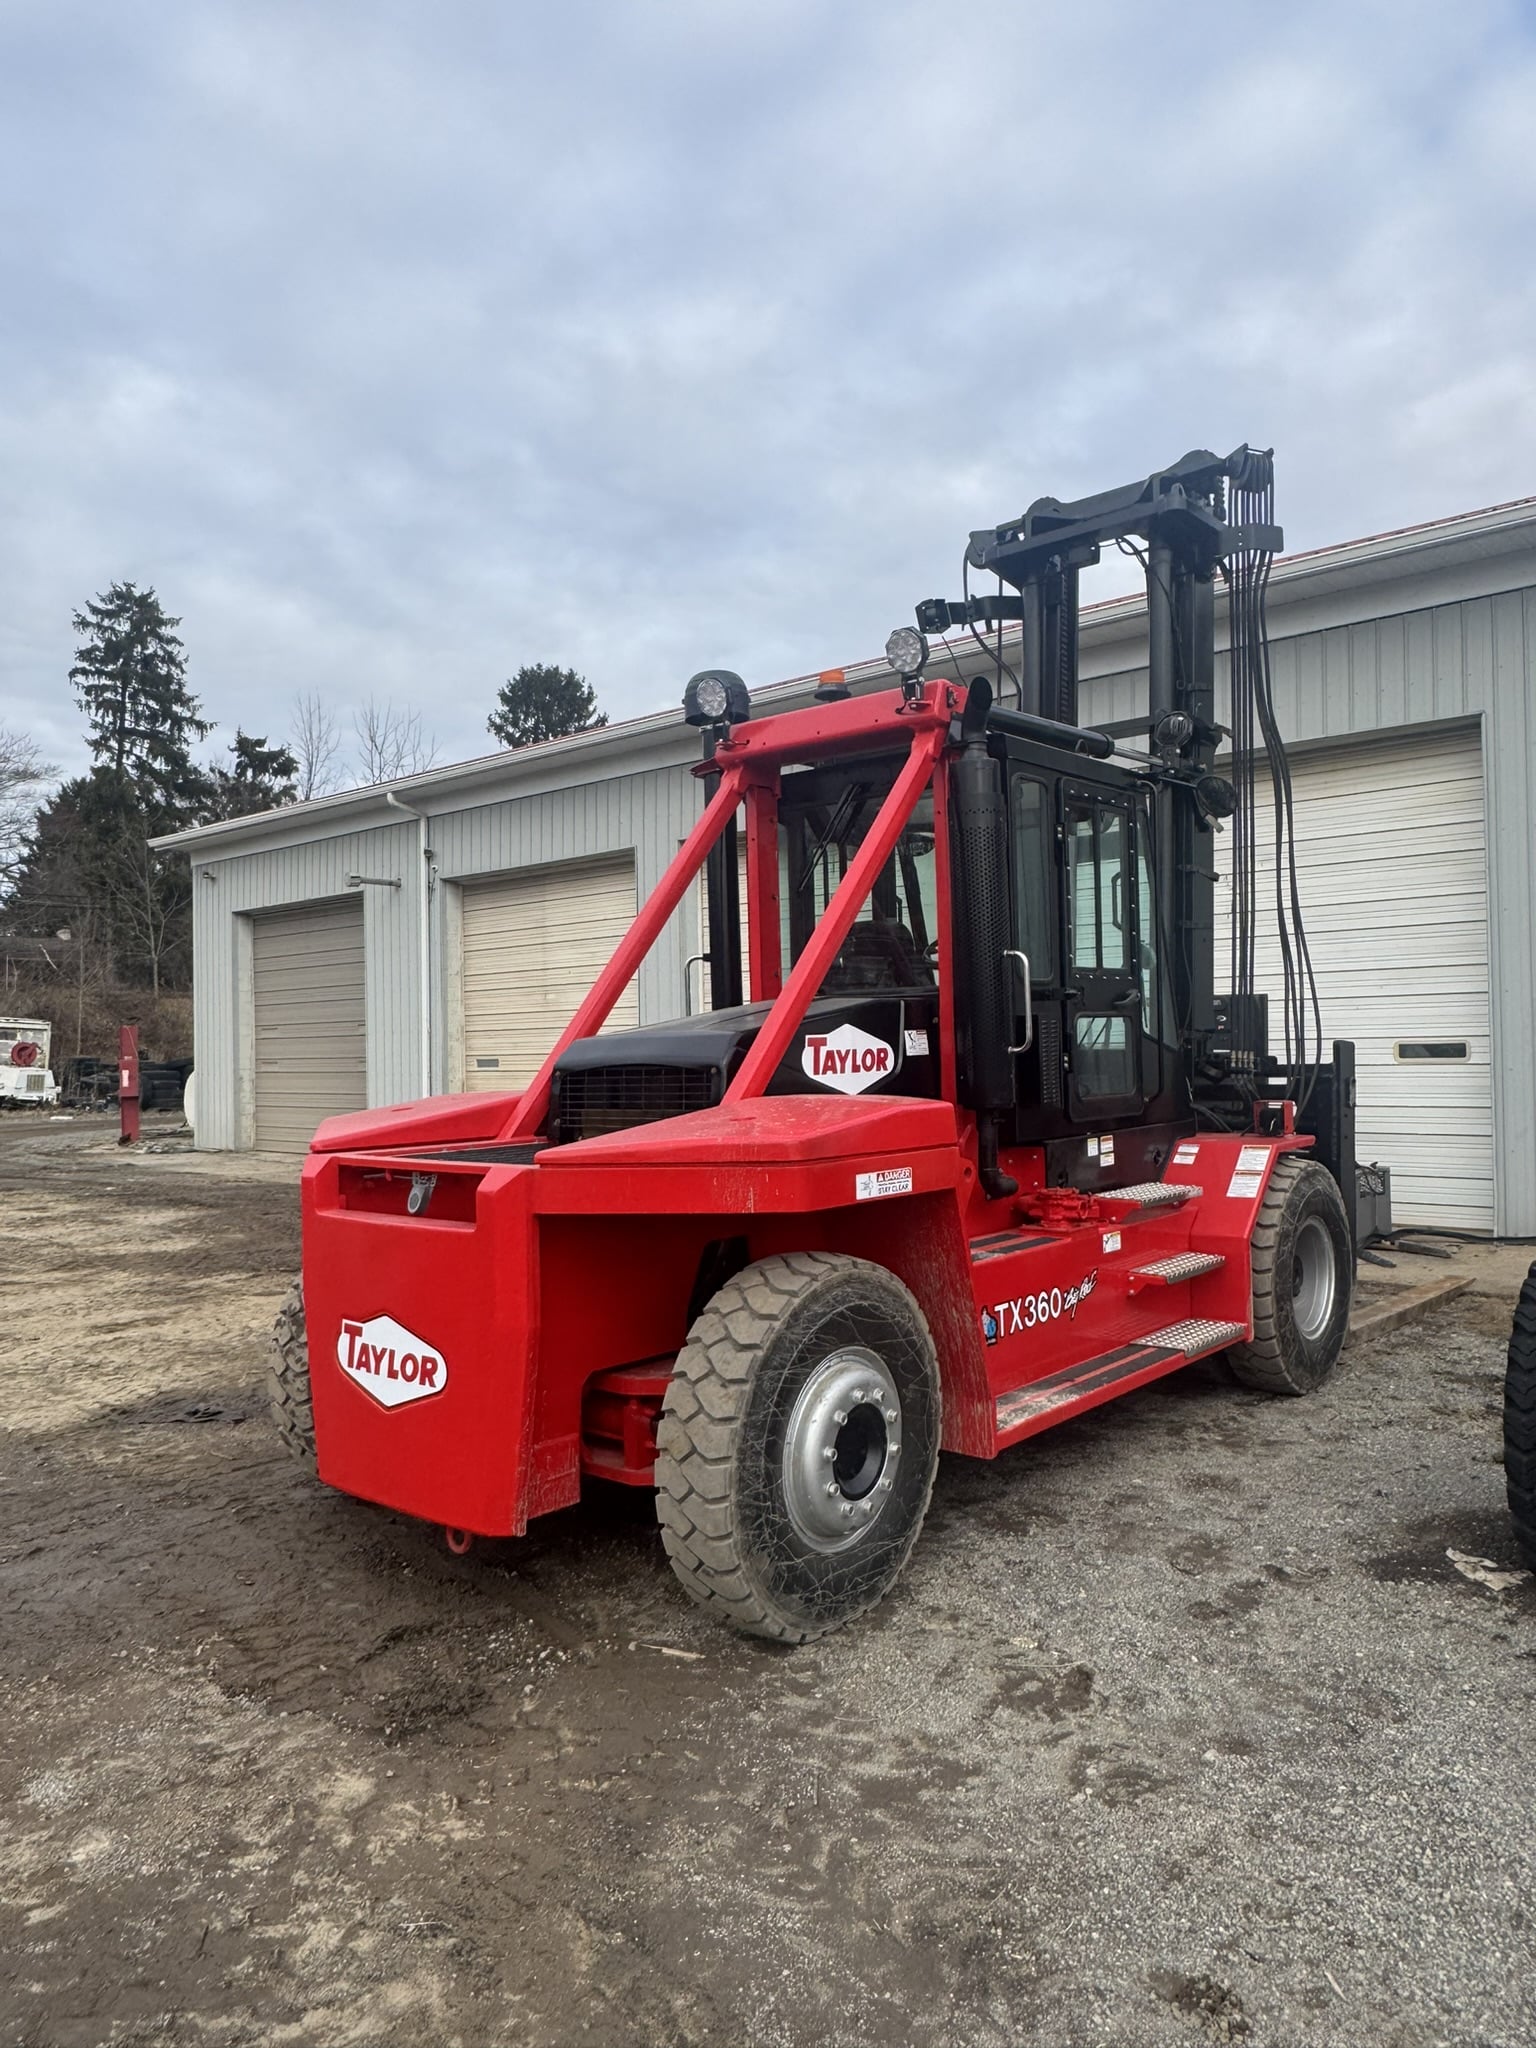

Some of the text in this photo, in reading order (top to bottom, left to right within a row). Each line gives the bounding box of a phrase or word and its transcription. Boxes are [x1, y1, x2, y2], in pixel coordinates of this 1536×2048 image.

[807, 1037, 888, 1076] TAYLOR
[879, 1186, 891, 1194] STAY
[892, 1183, 909, 1192] CLEAR
[884, 1169, 910, 1180] DANGER
[994, 1287, 1062, 1337] TX360
[344, 1323, 438, 1388] TAYLOR
